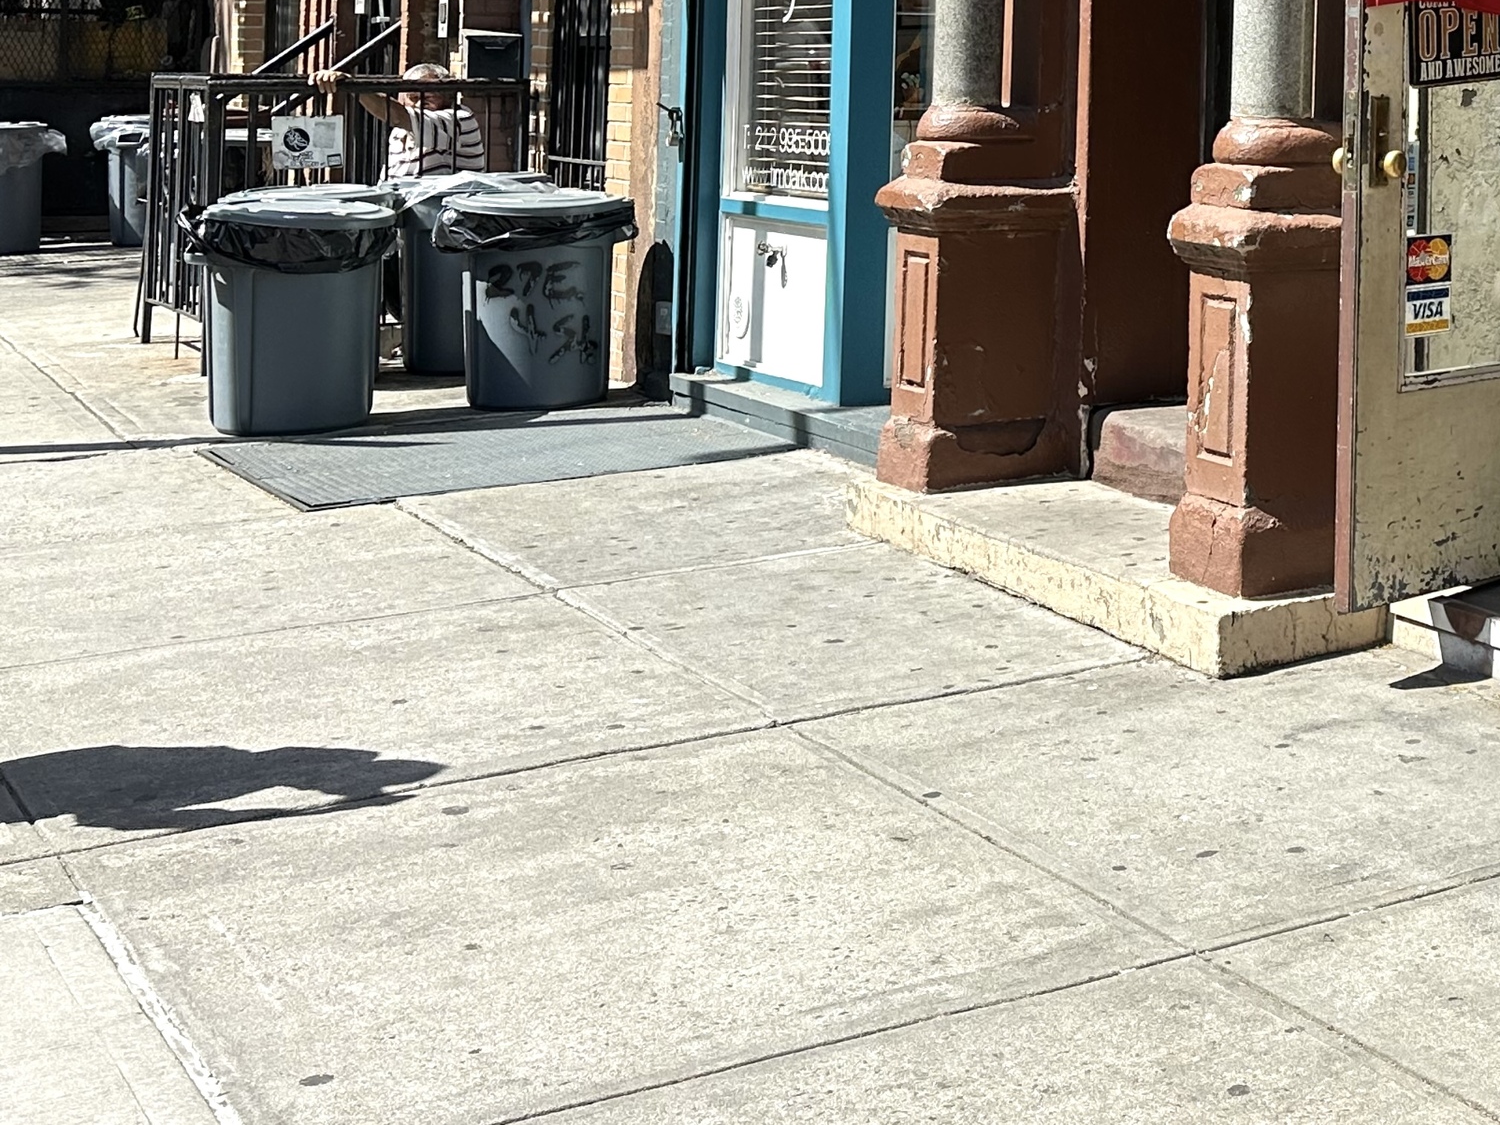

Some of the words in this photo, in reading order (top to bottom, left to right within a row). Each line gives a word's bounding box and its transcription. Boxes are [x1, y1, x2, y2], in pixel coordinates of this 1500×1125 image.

[1418, 7, 1500, 62] OPEN
[1419, 60, 1443, 81] AND
[1445, 54, 1500, 79] AWESOME
[1412, 301, 1443, 320] VISA
